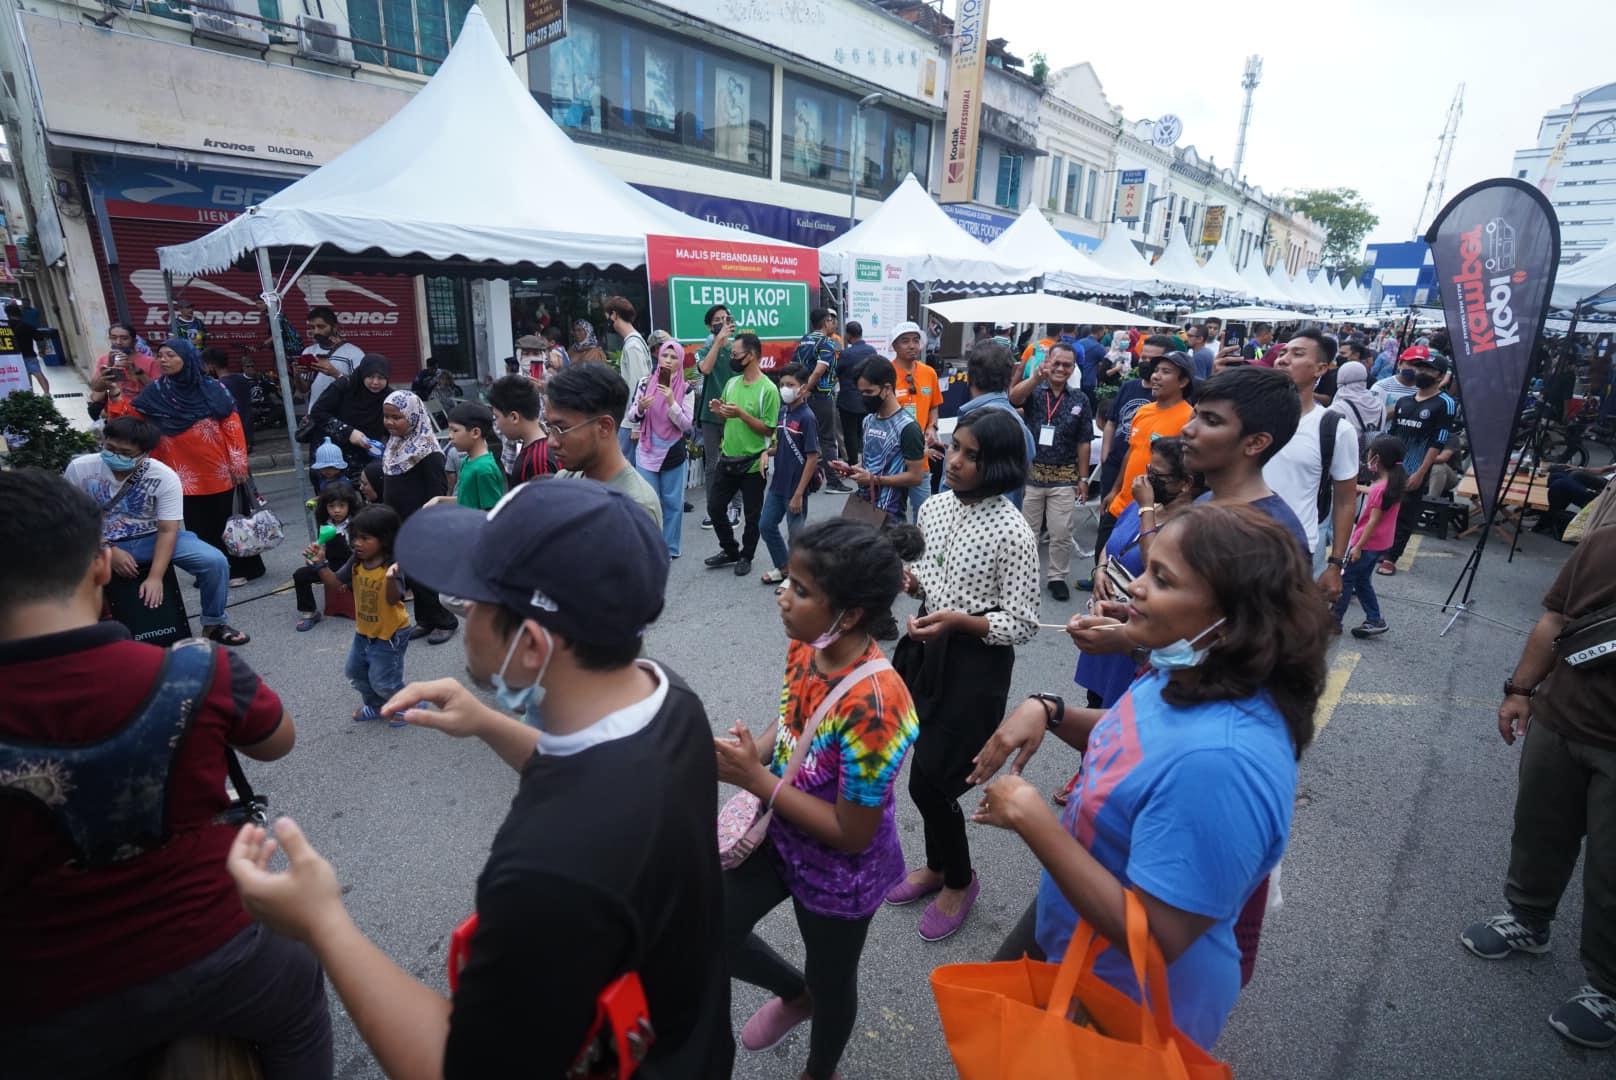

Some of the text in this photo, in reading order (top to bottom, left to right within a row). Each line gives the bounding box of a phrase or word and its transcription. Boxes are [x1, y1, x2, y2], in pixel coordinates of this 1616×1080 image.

[960, 90, 971, 145] PROFESSIONAL
[203, 138, 256, 152] kronos
[267, 145, 314, 158] DIADORA
[950, 127, 960, 161] Kodak
[675, 248, 798, 266] MAJLIS PERBANDARAN KAJANG
[690, 285, 790, 306] LEBUH KOPI
[734, 309, 780, 327] JANG
